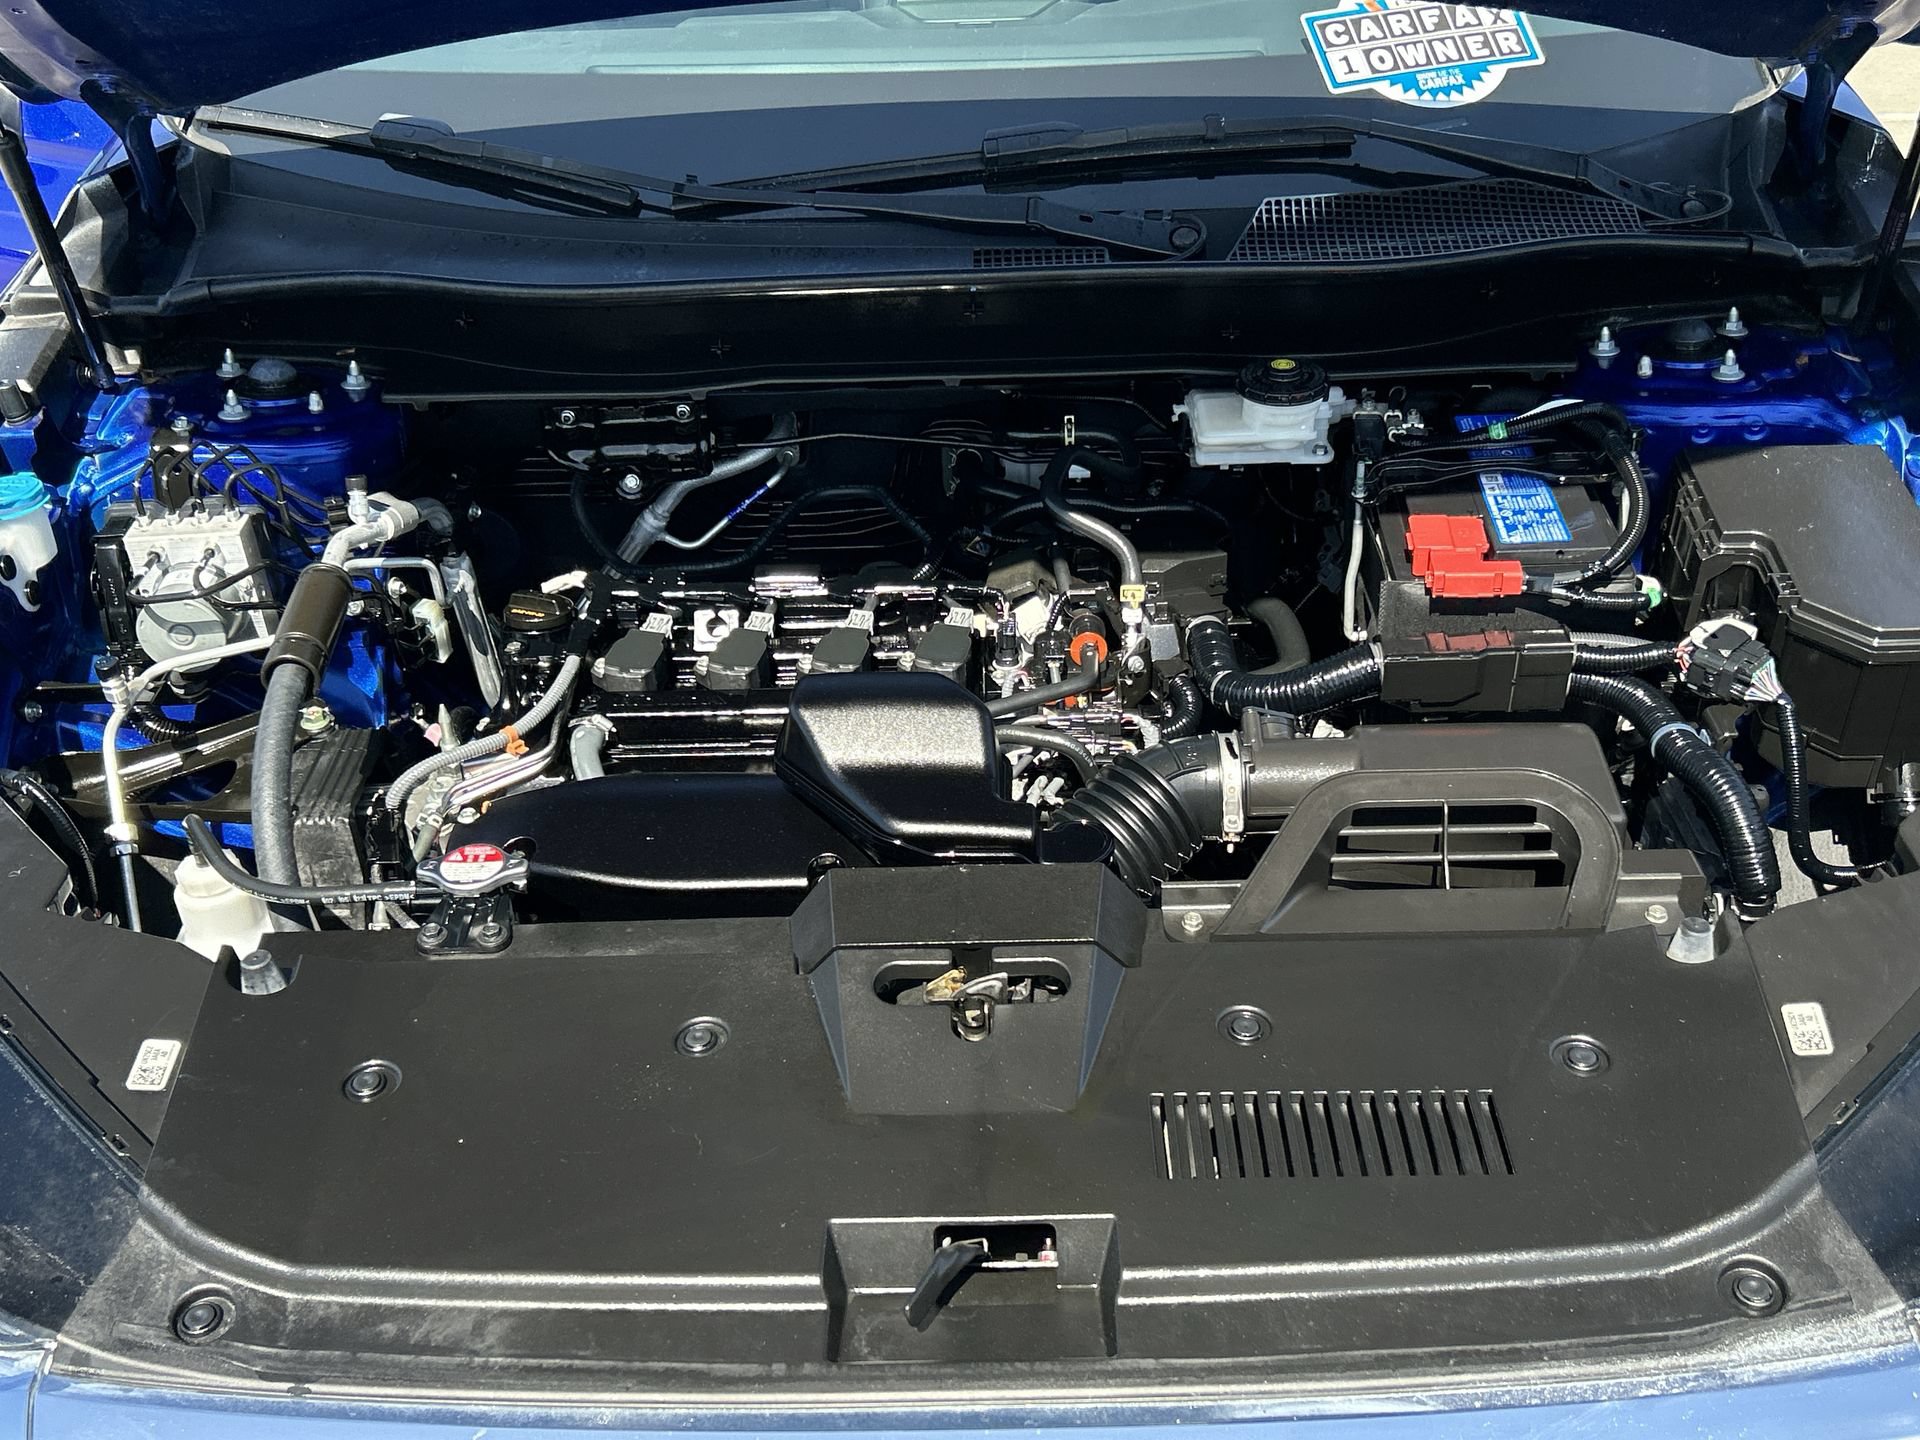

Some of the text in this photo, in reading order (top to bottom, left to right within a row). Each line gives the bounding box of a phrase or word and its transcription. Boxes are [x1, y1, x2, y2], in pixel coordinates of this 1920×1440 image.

[1324, 5, 1512, 45] CARFAX
[1338, 31, 1522, 75] 1 OWNER
[1418, 75, 1466, 91] CARFAX
